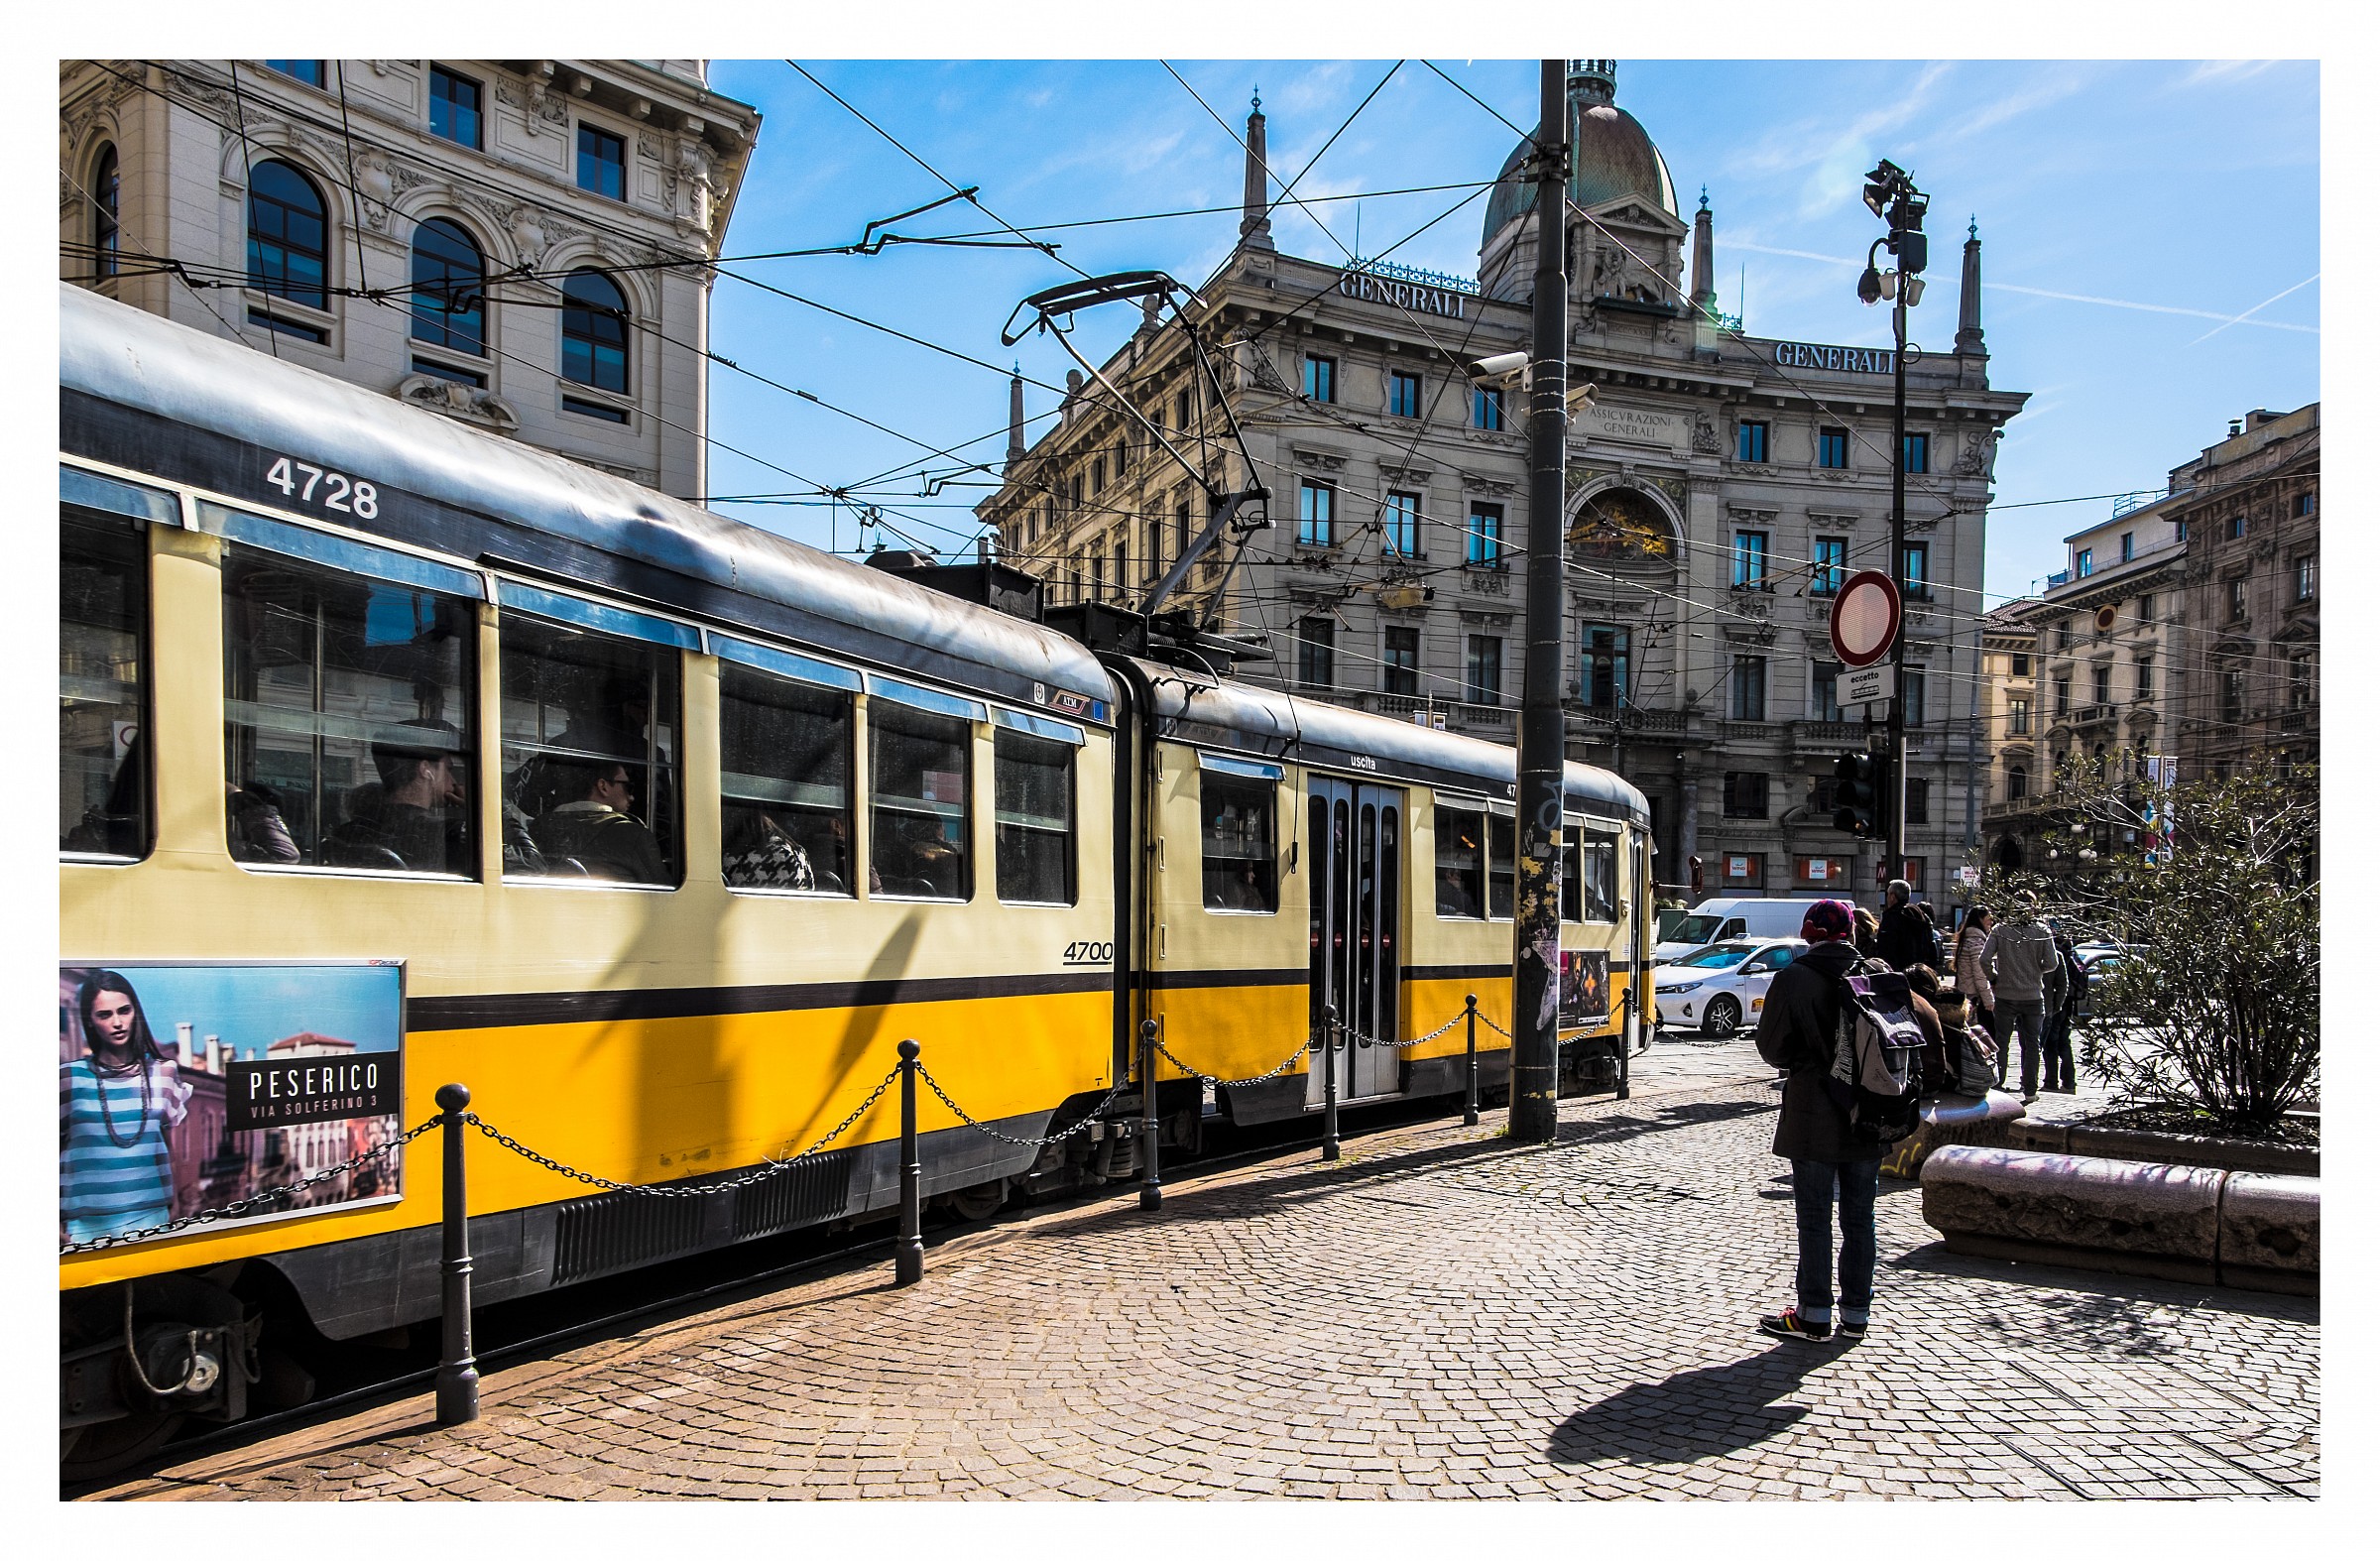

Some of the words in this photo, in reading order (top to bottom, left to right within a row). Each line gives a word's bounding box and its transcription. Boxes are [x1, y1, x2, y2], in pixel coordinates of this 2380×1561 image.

[1339, 272, 1466, 319] GENERALI
[1775, 342, 1896, 374] GENERALI
[267, 457, 379, 520] 4728
[1850, 671, 1879, 683] eccetto
[1063, 695, 1077, 708] ATM
[1351, 755, 1376, 771] uscita
[1507, 783, 1517, 797] 47
[1063, 941, 1113, 961] 4700
[250, 1063, 378, 1100] PESERICO
[251, 1106, 276, 1119] VIA
[286, 1096, 363, 1116] SOLFERINO
[371, 1095, 377, 1107] 3
